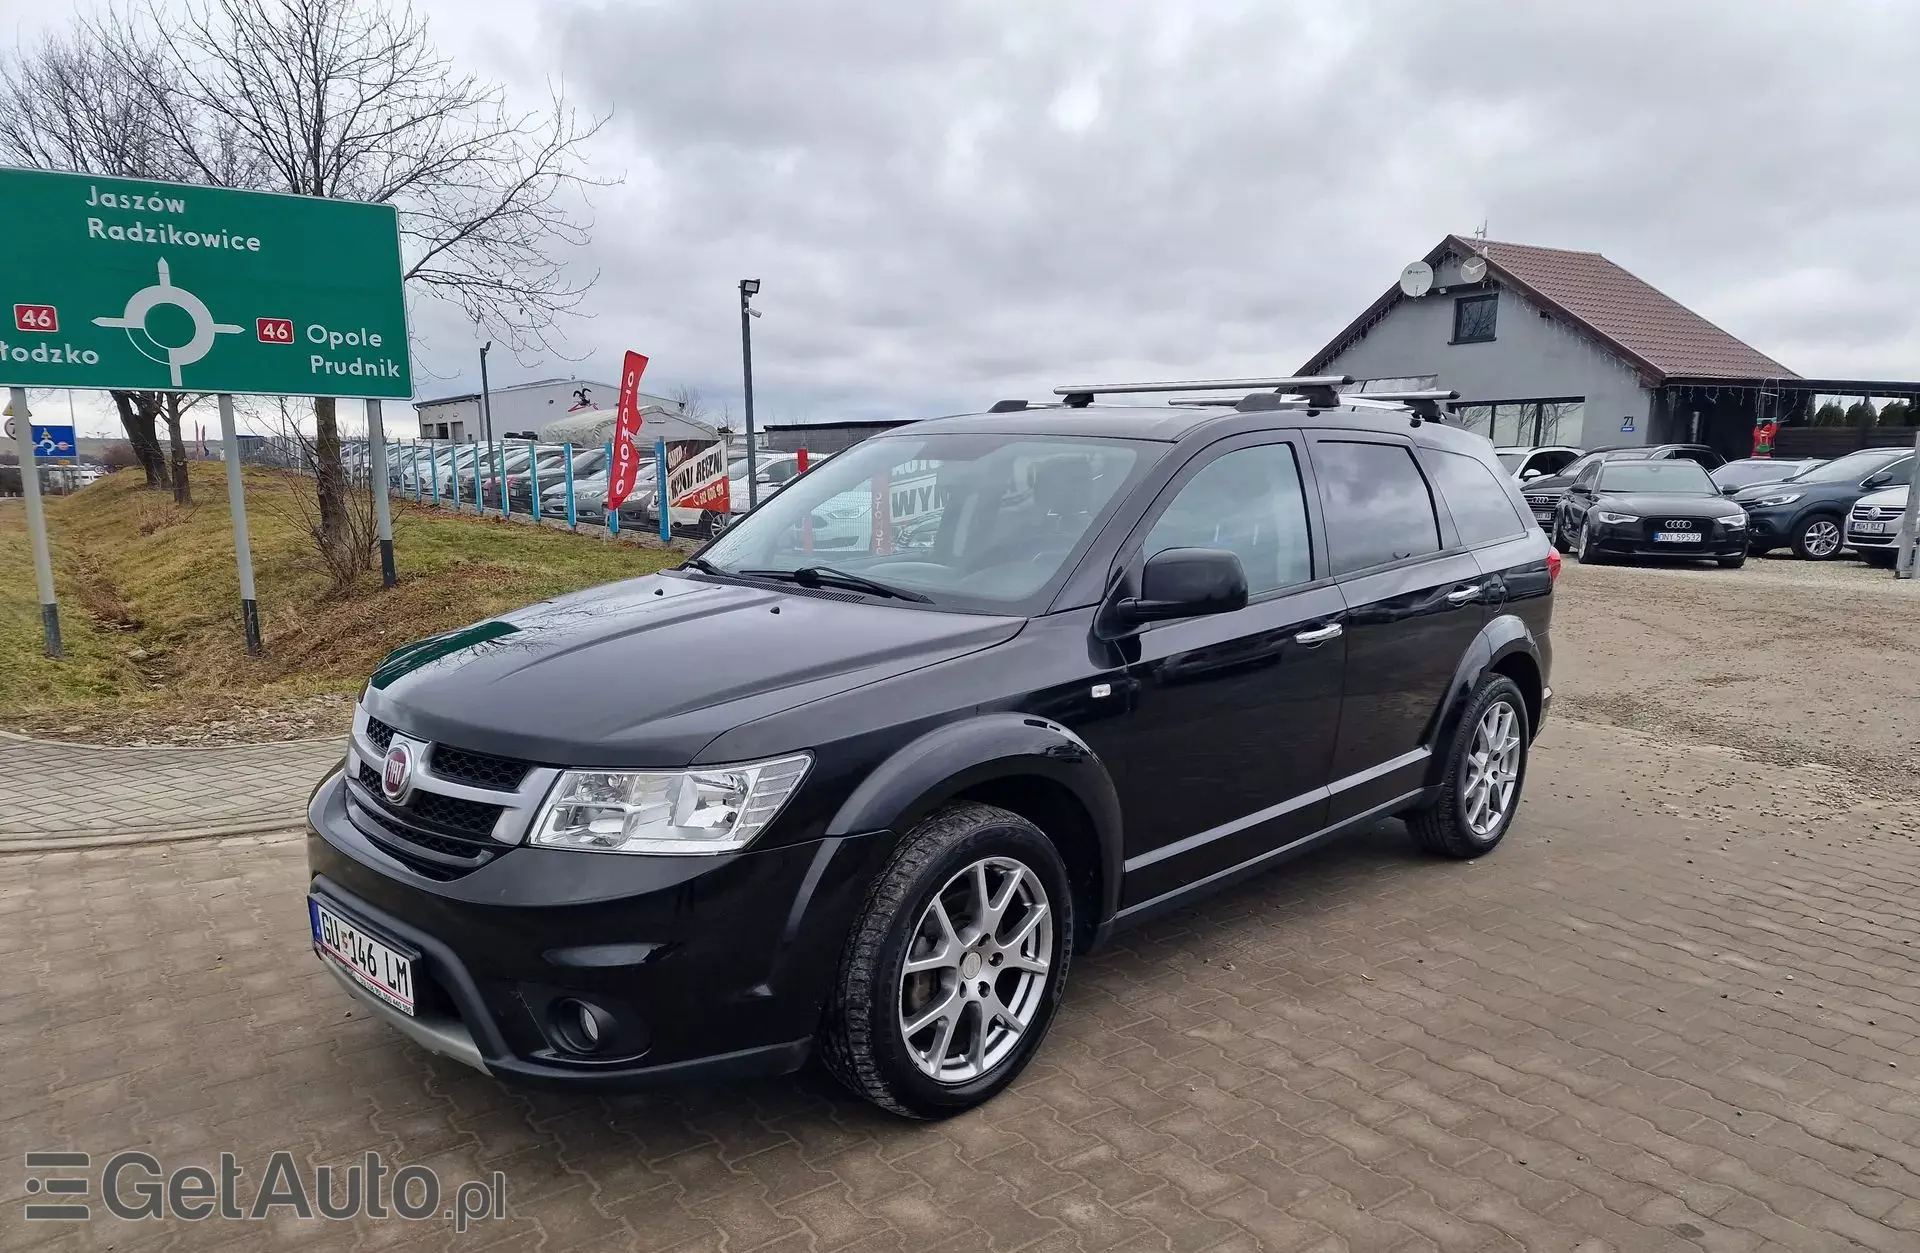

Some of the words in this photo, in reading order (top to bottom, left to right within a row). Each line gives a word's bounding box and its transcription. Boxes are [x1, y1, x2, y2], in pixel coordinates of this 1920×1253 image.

[85, 185, 186, 214] Jaszów
[87, 217, 261, 252] Radzikowice
[21, 309, 52, 328] 46
[262, 322, 289, 341] 46
[306, 323, 383, 350] Opole
[310, 355, 400, 379] Prudnik
[615, 371, 635, 495] OTOMOTO
[1623, 415, 1634, 426] 71
[386, 758, 404, 786] FIAT
[321, 911, 340, 953] GU
[348, 931, 377, 978] 146
[385, 951, 409, 998] LM
